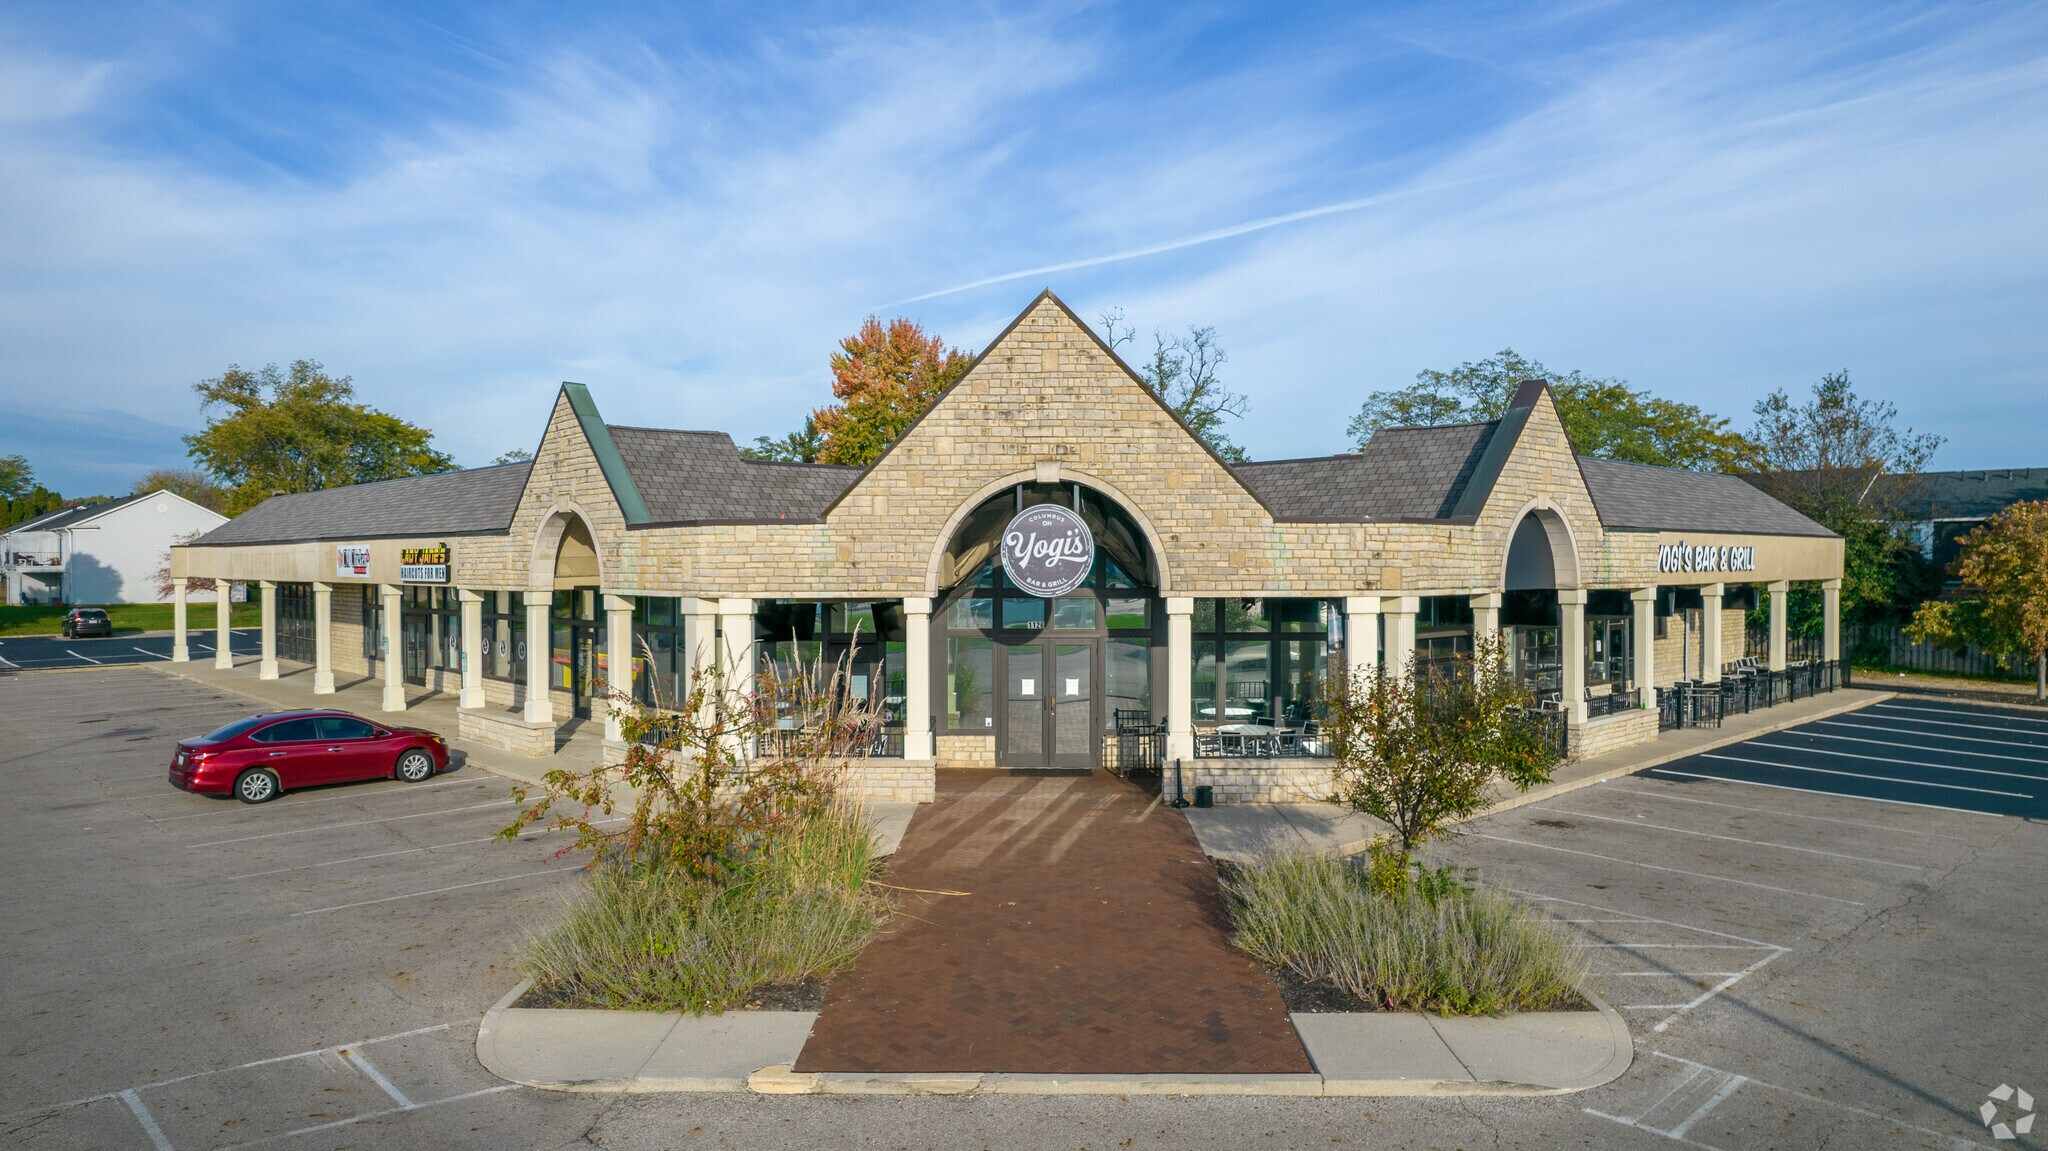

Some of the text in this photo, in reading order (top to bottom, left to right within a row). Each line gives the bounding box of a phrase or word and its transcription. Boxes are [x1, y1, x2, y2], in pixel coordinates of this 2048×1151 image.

[1028, 513, 1066, 523] COLUMBUS
[1006, 528, 1088, 569] Yogi's
[400, 548, 419, 564] LADY
[1694, 545, 1717, 571] BAR
[1720, 545, 1728, 571] &
[1731, 546, 1755, 571] GRILL
[400, 567, 446, 580] HAIRCUTS FOR MEN
[1026, 577, 1041, 588] BAR
[1047, 577, 1068, 588] GRILL
